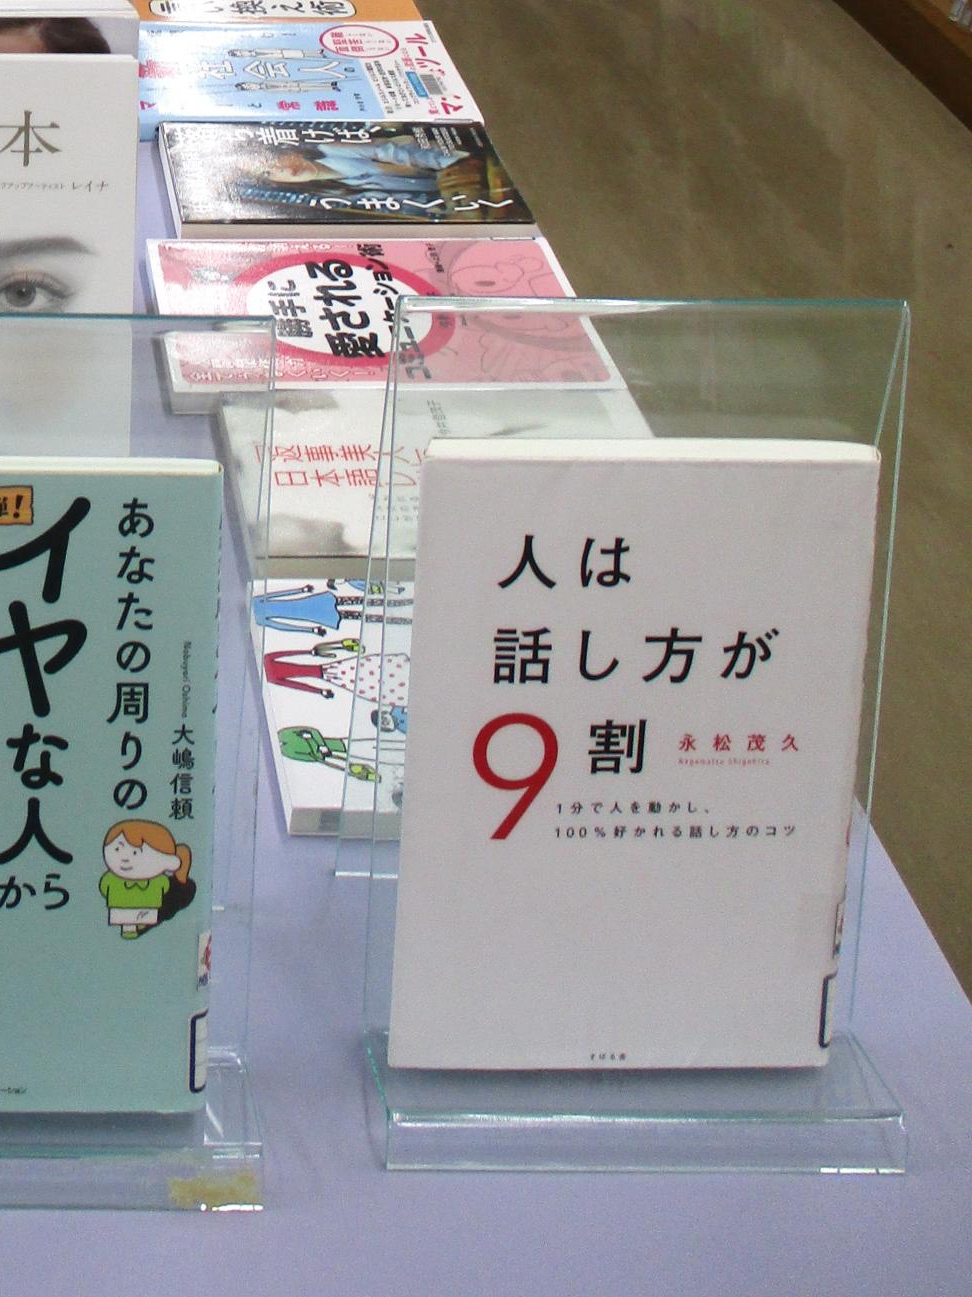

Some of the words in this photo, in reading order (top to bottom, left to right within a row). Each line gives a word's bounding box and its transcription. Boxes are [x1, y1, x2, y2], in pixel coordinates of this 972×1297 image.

[71, 180, 109, 192] レイナ
[309, 195, 514, 210] うまくいく
[267, 280, 314, 337] 勝手に
[306, 259, 386, 358] 愛される
[498, 533, 632, 589] 人は
[107, 497, 155, 810] あなたの周りの
[493, 627, 779, 684] 話し方が
[679, 734, 799, 752] 永松茂久
[169, 724, 195, 819] 大嶋信頼
[555, 825, 797, 839] 100%好かれる話し方のコツ
[556, 801, 710, 814] 1分で人を動かし、
